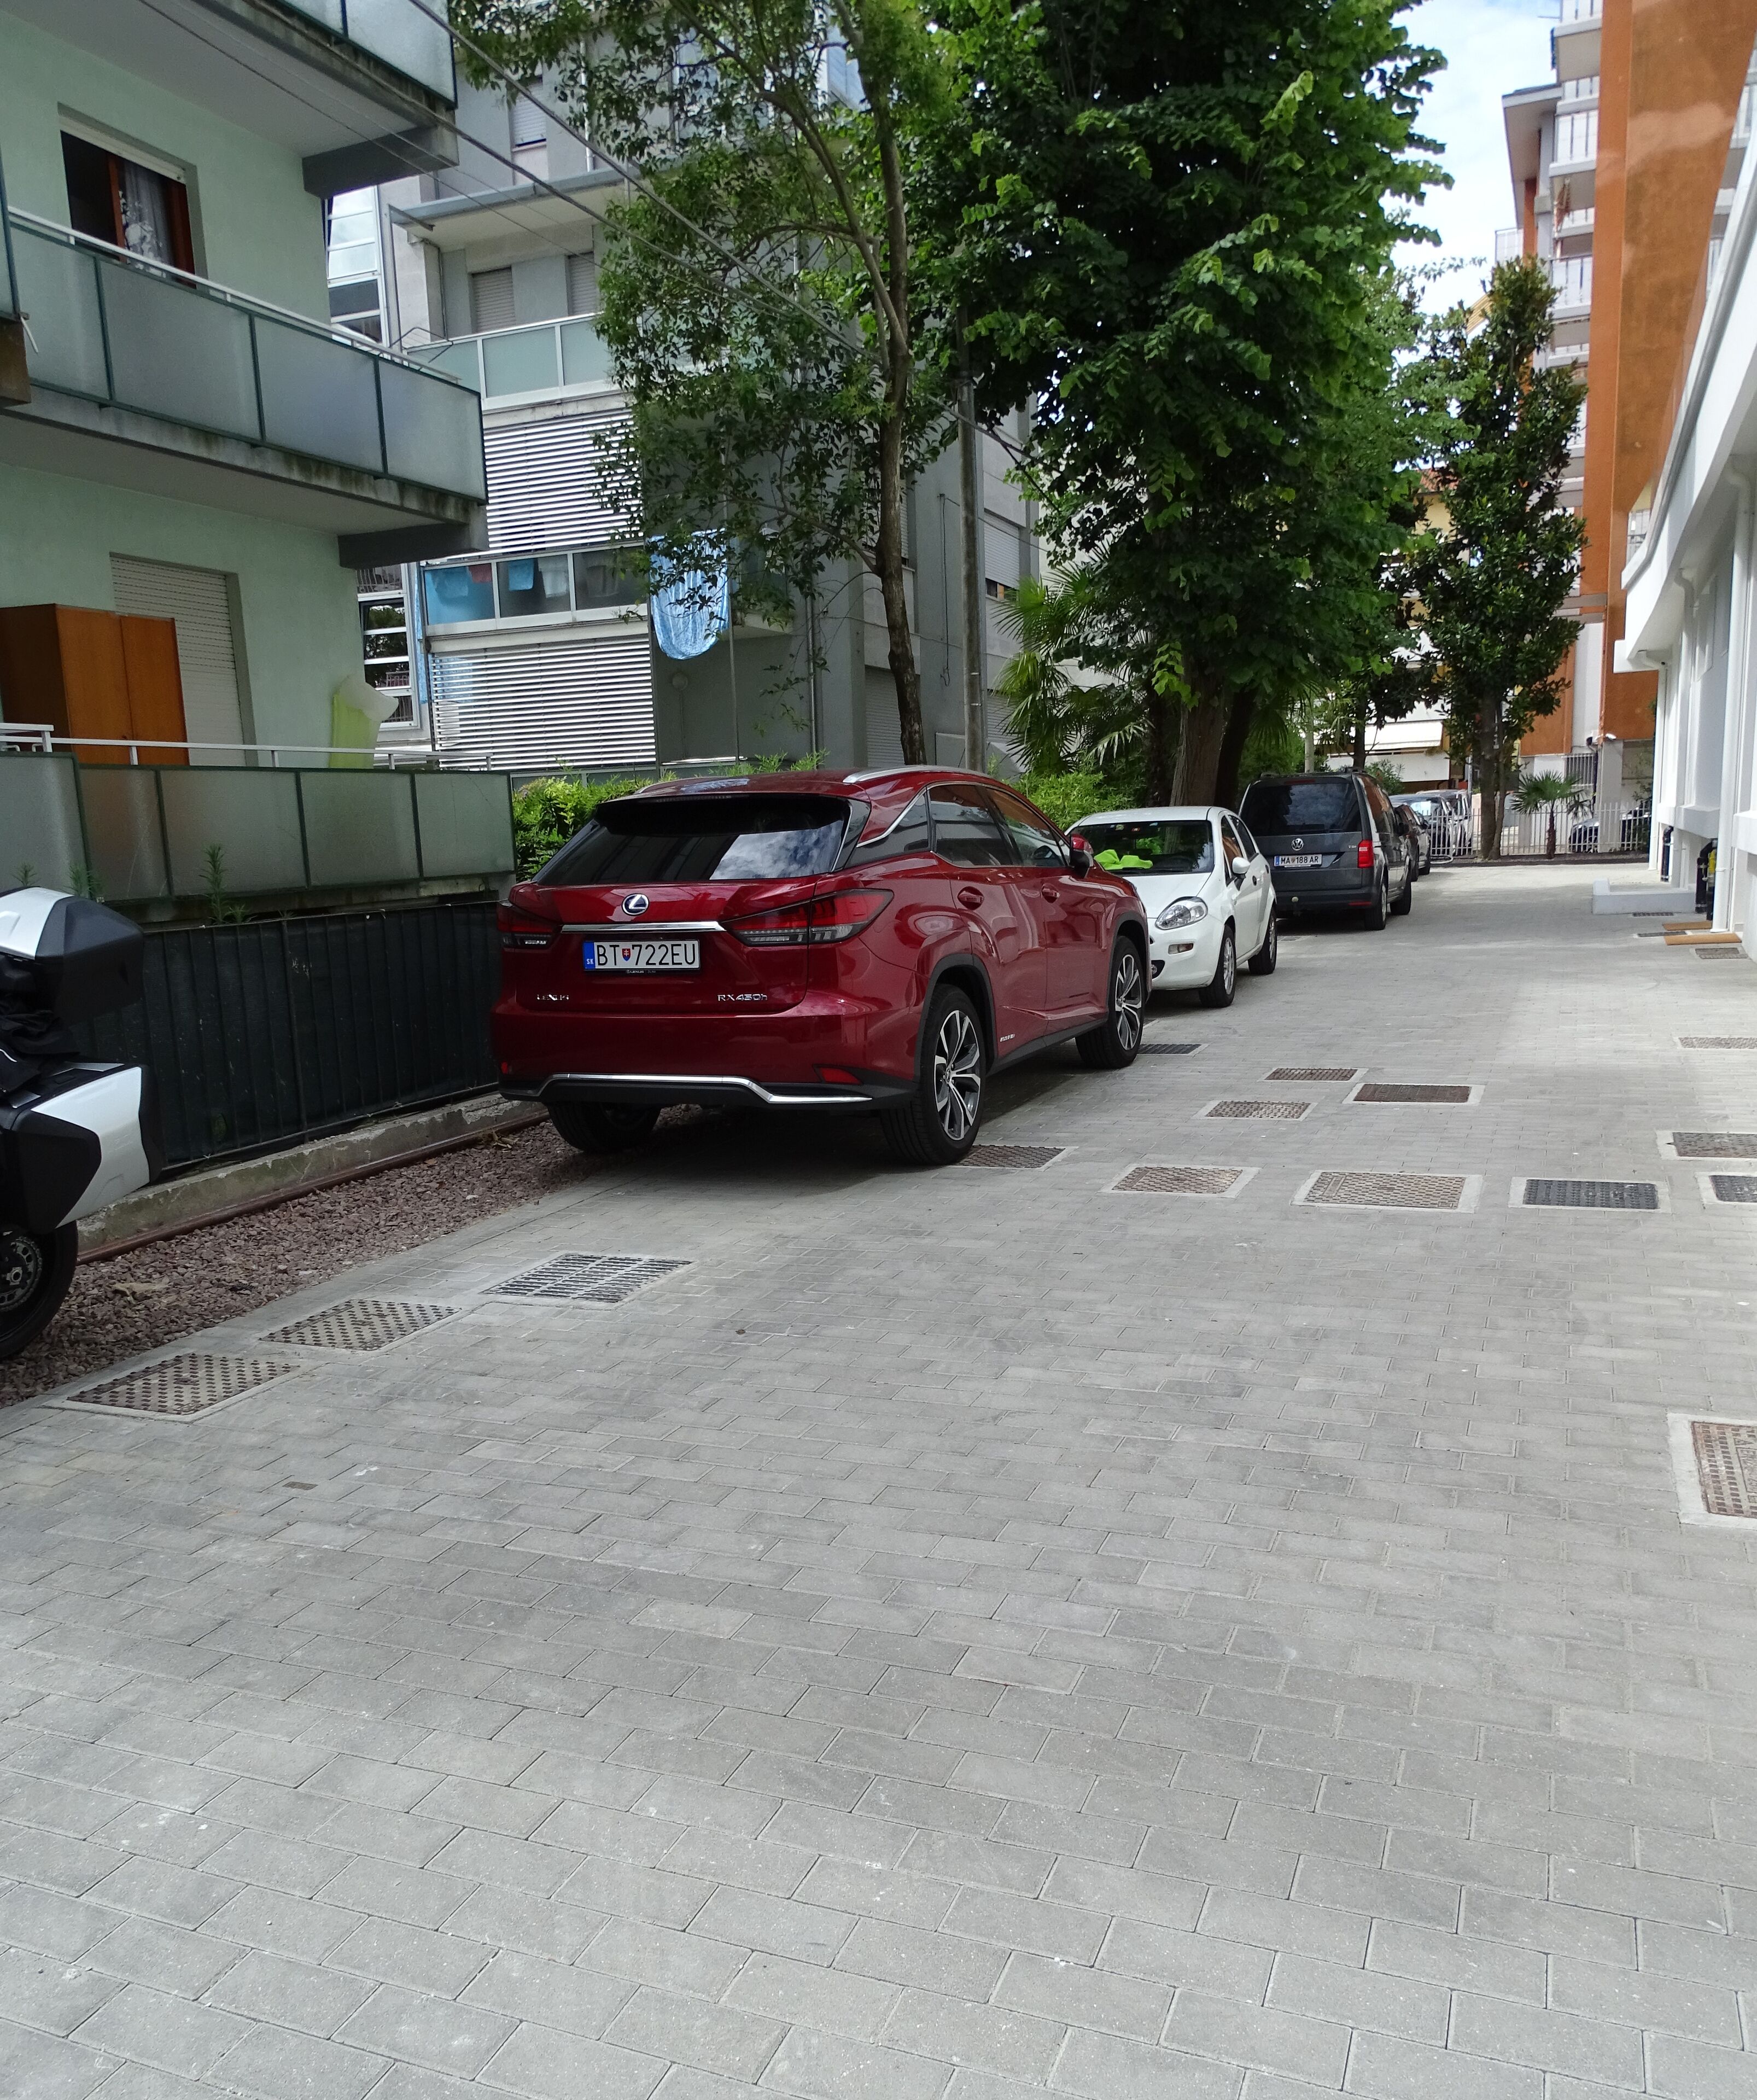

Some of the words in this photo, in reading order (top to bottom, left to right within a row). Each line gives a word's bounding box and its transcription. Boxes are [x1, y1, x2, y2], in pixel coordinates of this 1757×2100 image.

[597, 944, 620, 966] BT
[632, 943, 696, 966] 722EU
[717, 993, 768, 1002] RX450h
